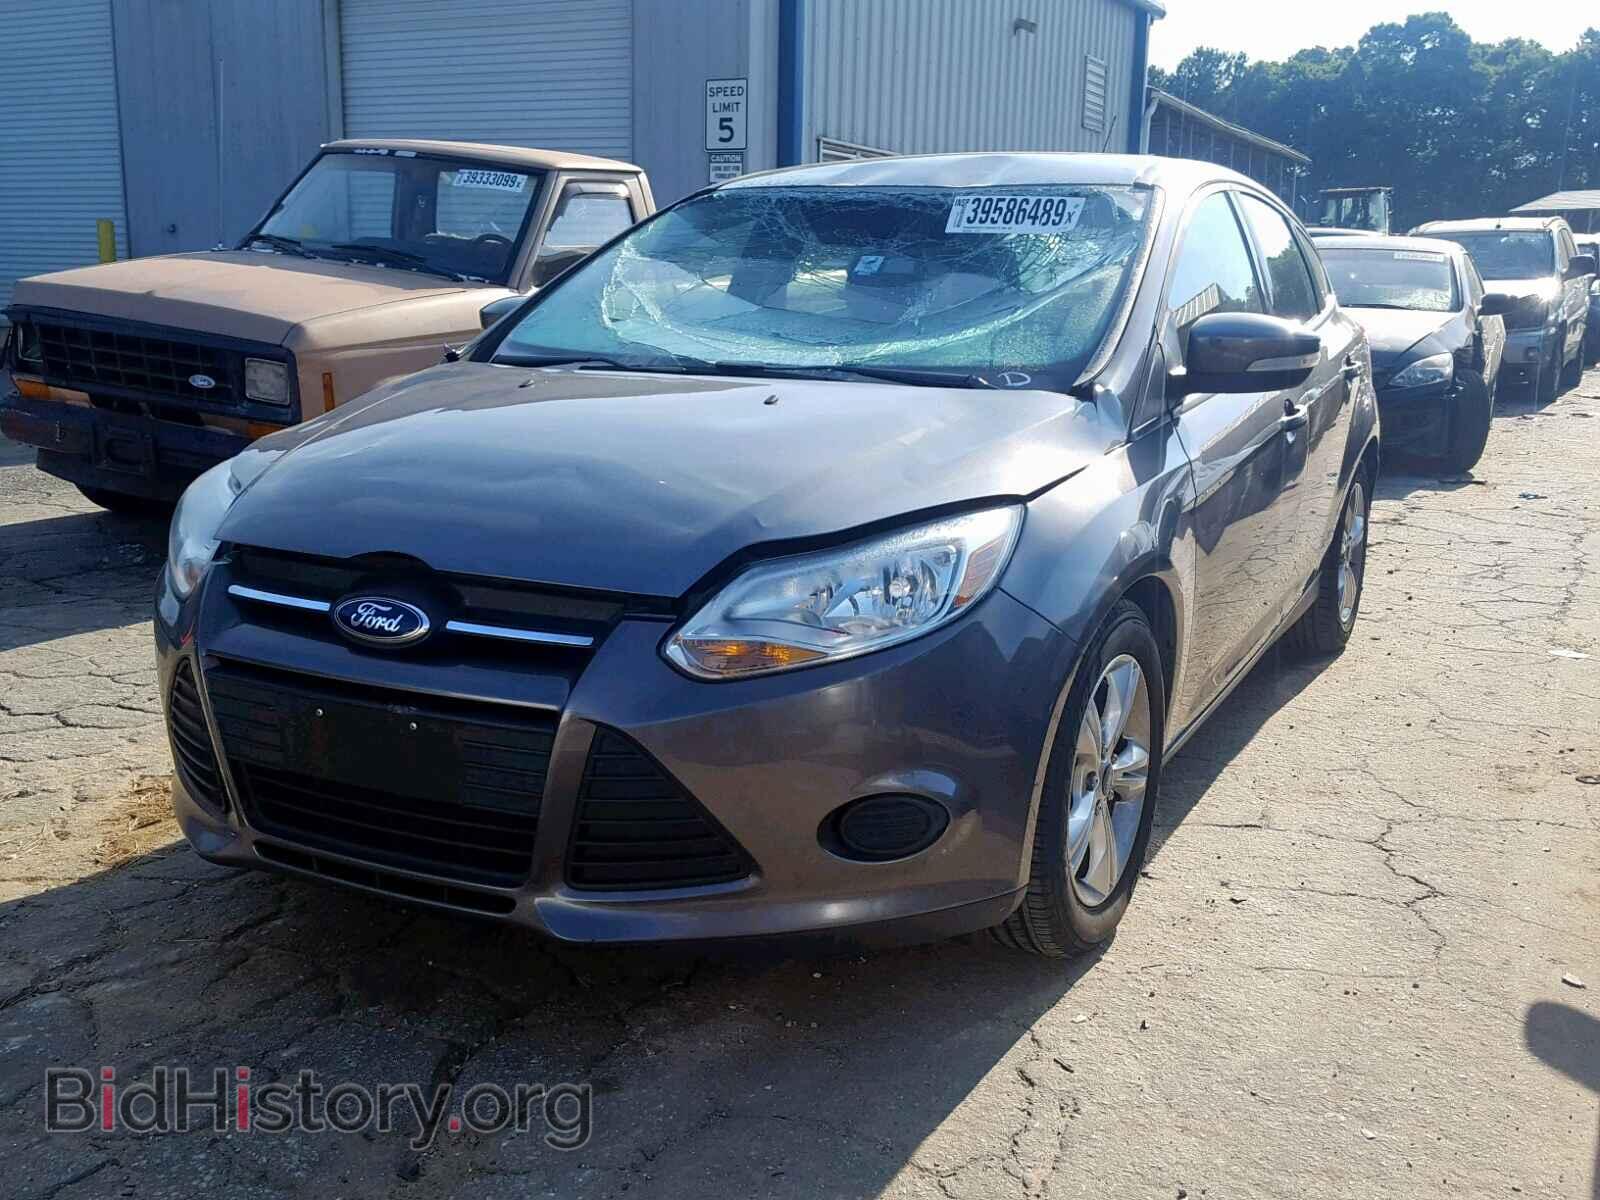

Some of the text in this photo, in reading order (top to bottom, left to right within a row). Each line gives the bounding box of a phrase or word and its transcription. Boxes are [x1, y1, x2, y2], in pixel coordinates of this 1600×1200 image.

[709, 86, 745, 97] SPEED
[712, 102, 741, 113] LIMIT
[718, 117, 734, 143] 5
[966, 198, 1068, 226] 39586489
[350, 602, 404, 632] Ford
